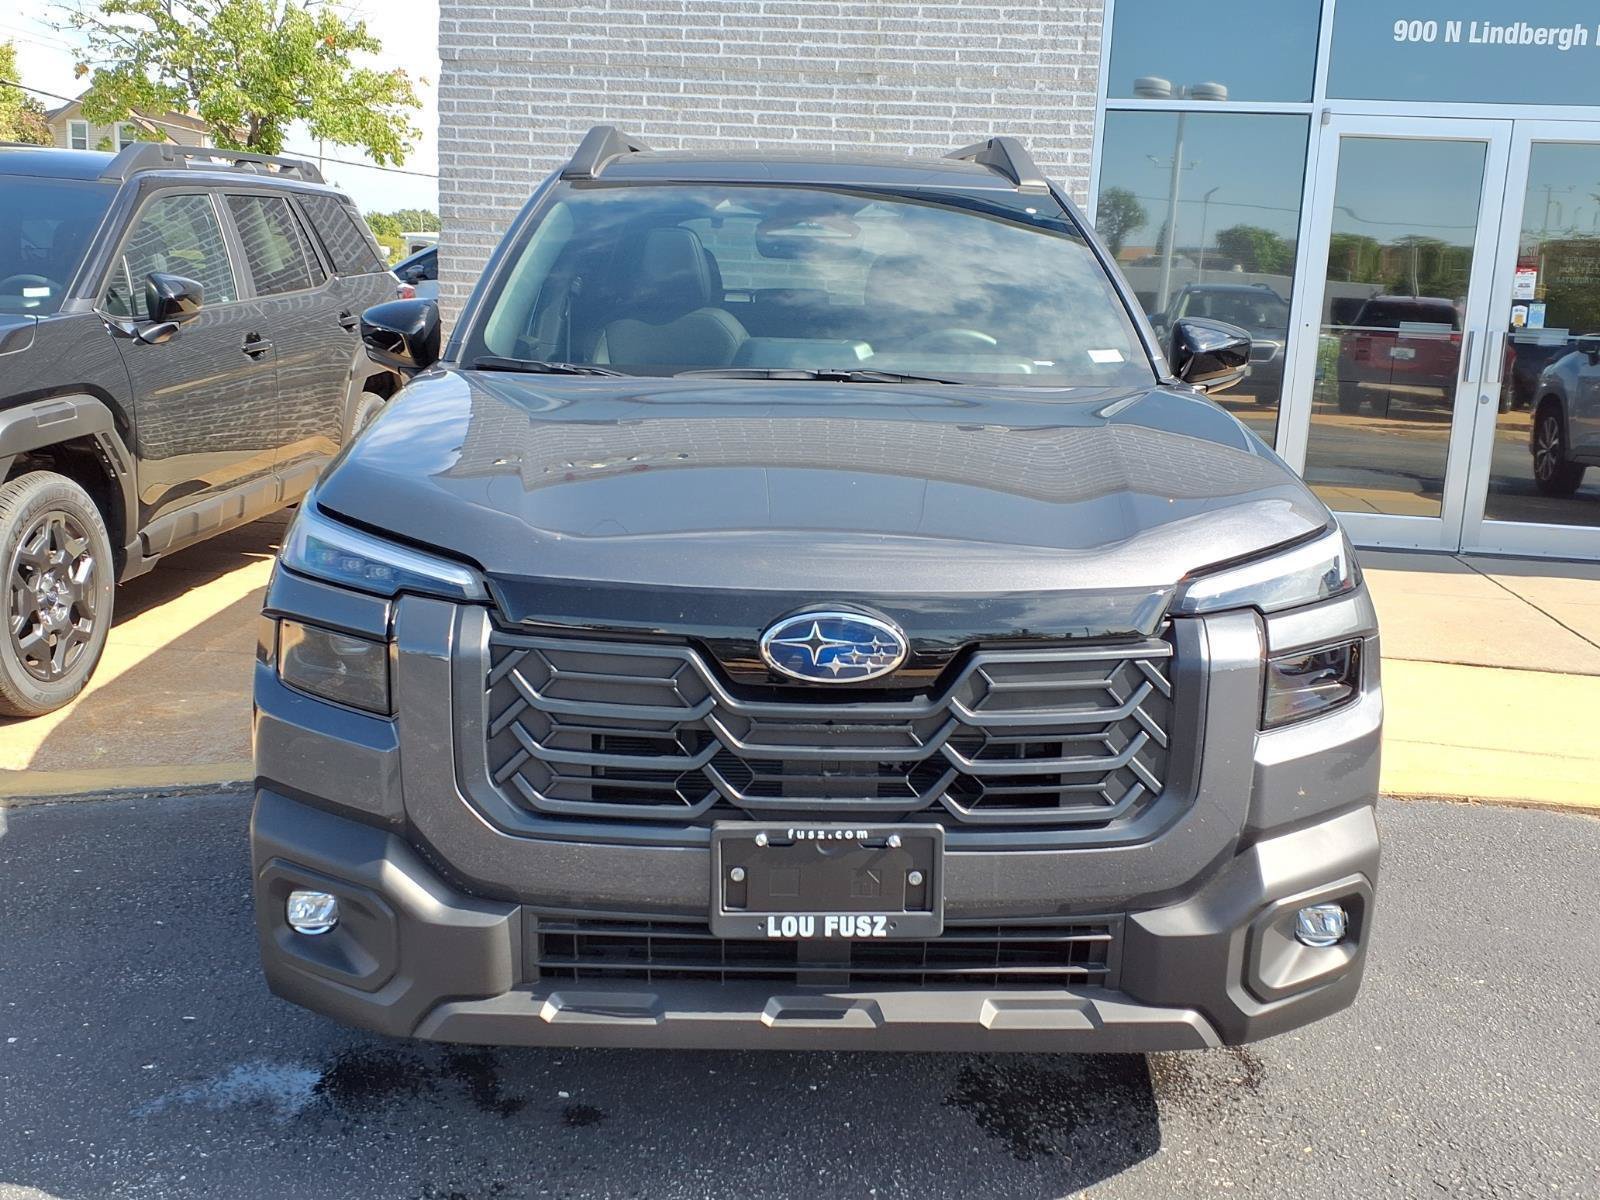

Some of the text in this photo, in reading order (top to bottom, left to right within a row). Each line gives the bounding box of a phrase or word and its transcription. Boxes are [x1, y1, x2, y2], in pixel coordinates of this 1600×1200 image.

[1393, 20, 1437, 43] 900
[1444, 21, 1462, 43] N
[1469, 21, 1588, 51] Lindbergh
[787, 828, 869, 840] fusz.com
[767, 916, 887, 937] LOU FUSZ
